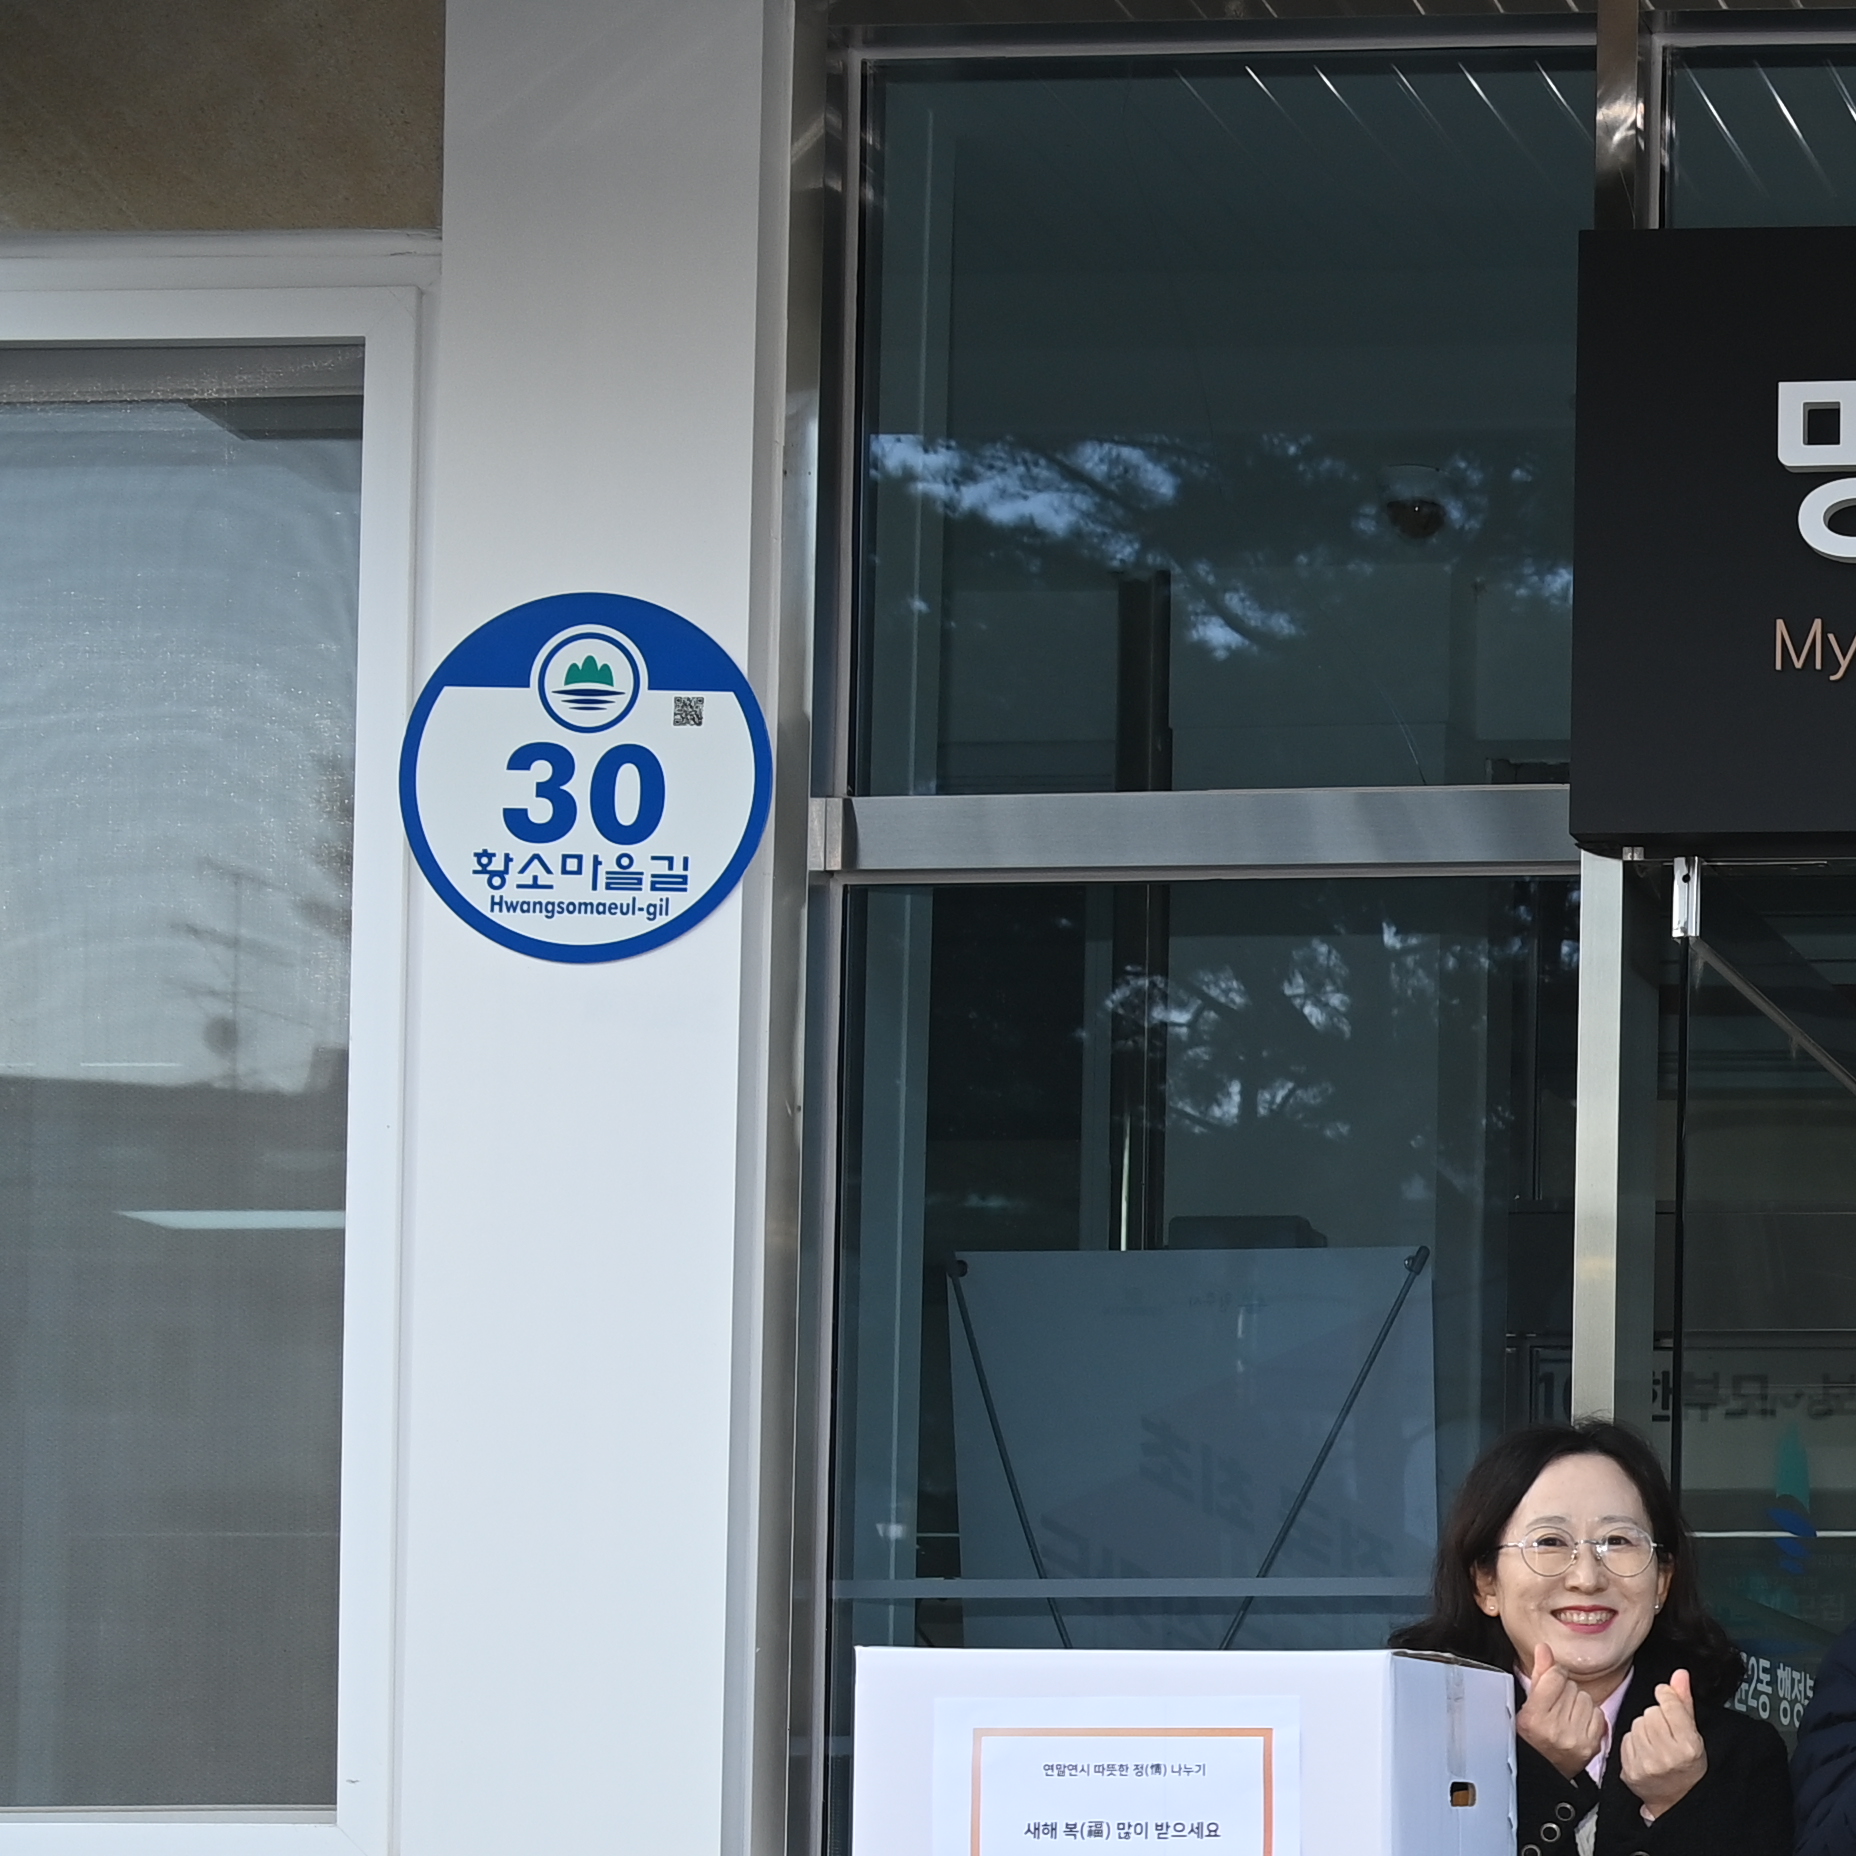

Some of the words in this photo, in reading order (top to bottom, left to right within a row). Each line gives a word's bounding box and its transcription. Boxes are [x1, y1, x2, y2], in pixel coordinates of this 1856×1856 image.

[502, 741, 666, 846] 30
[472, 849, 690, 893] 황소마을길
[489, 894, 670, 922] Hwangsomaeul-gil
[1042, 1763, 1091, 1778] 연말연시
[1093, 1763, 1130, 1777] 따뜻한
[1170, 1763, 1206, 1777] 나누기
[1023, 1821, 1058, 1840] 새해
[1116, 1821, 1149, 1841] 많이
[1154, 1821, 1222, 1840] 받으세요
